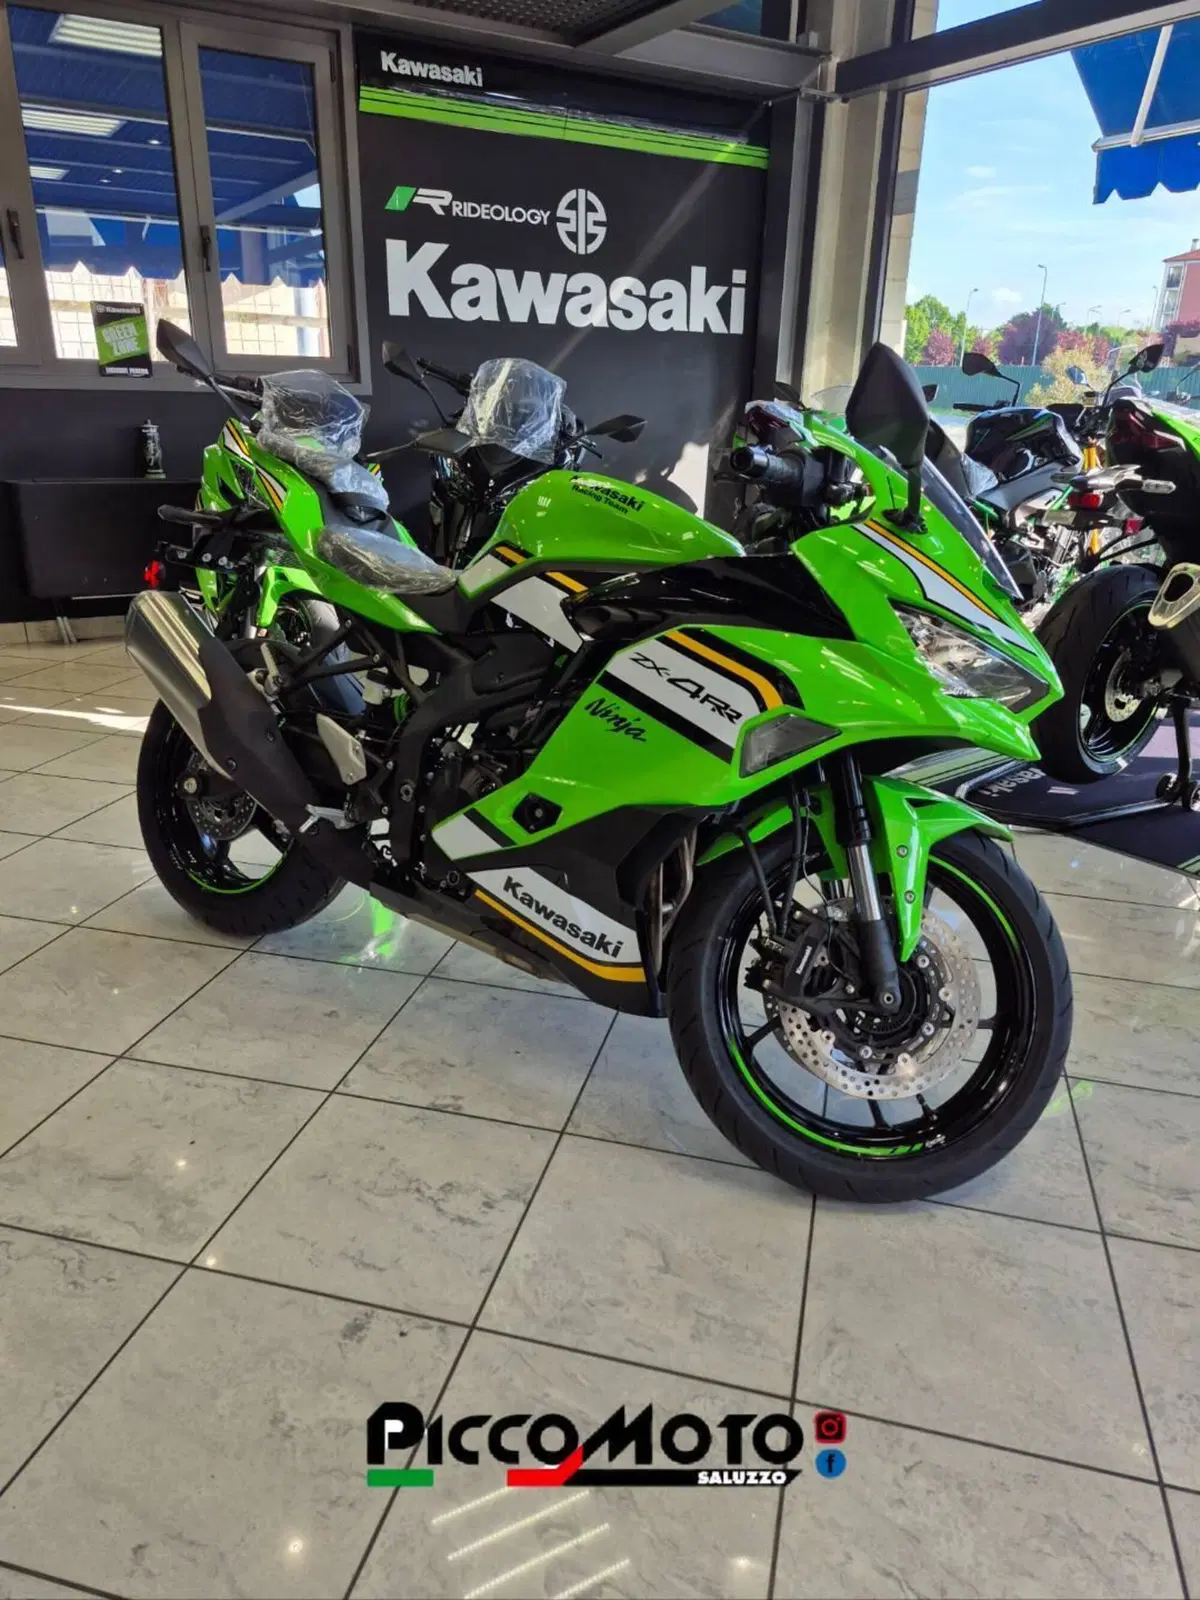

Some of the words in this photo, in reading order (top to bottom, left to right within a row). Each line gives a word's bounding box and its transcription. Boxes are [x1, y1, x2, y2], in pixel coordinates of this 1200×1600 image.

[380, 50, 483, 87] Kawasaki
[452, 201, 550, 225] RIDEOLOGY
[385, 238, 747, 335] Kawasaki
[572, 484, 603, 503] Racing
[604, 497, 628, 514] Team
[628, 651, 743, 725] ZX-4RR
[584, 697, 648, 743] Ninja
[503, 875, 625, 958] Kawasaki
